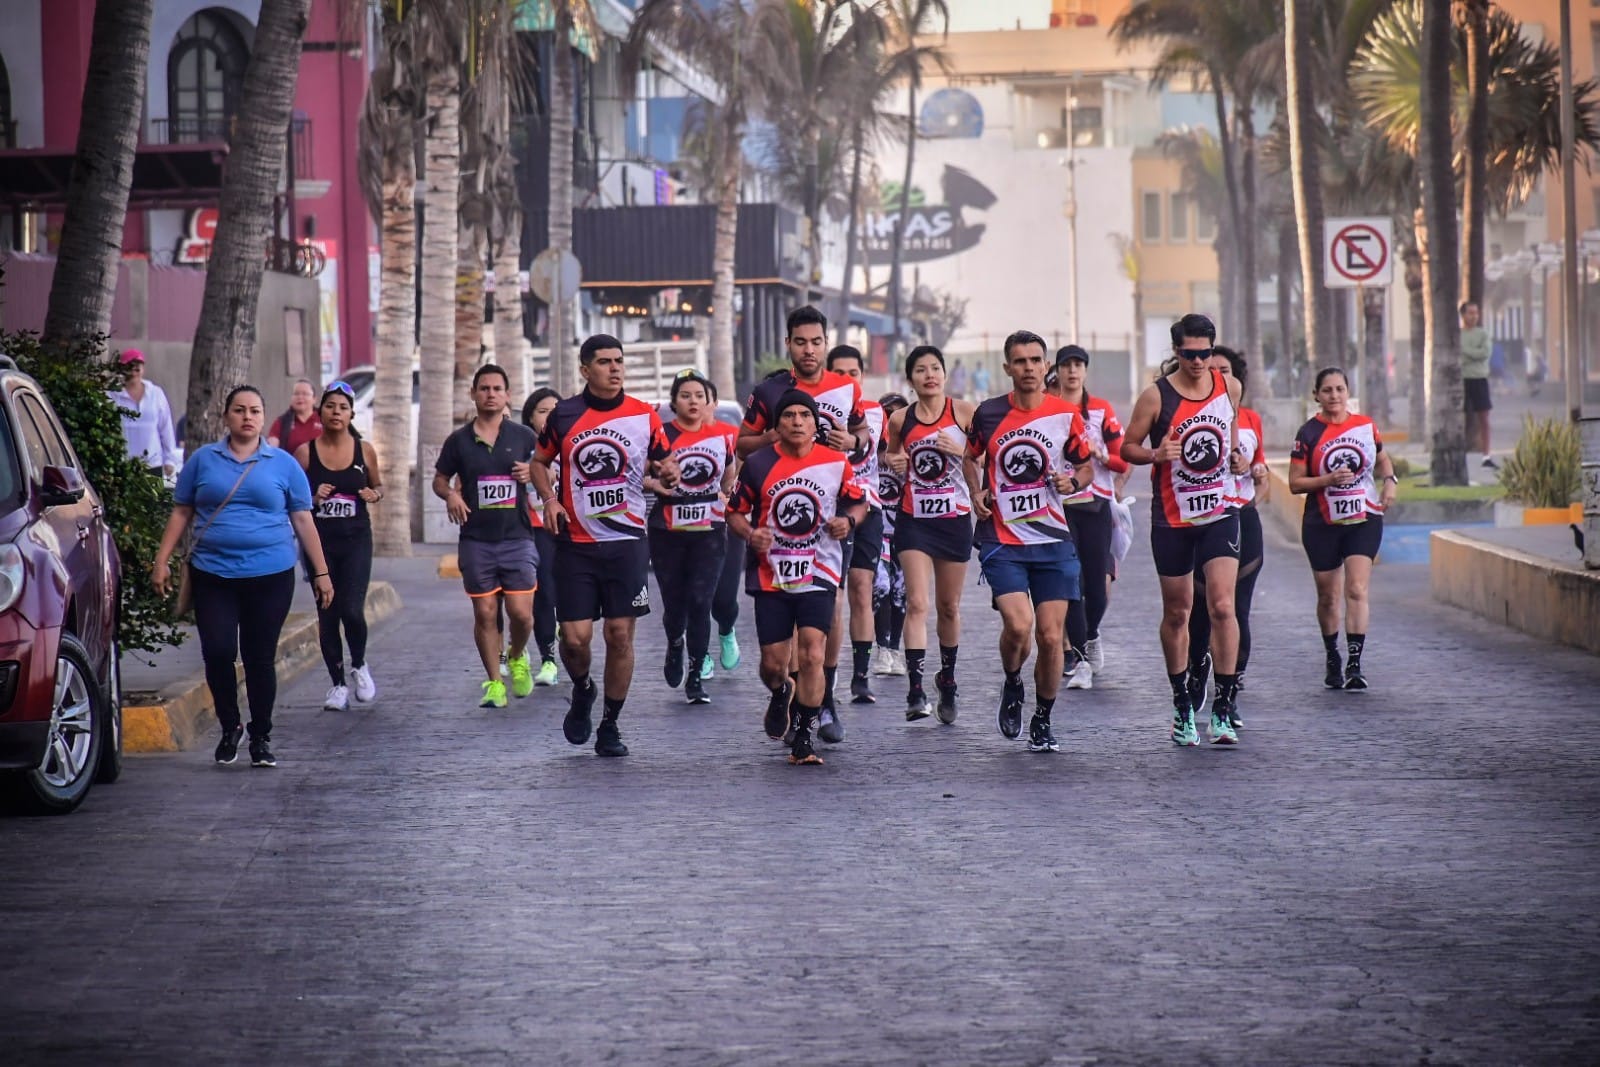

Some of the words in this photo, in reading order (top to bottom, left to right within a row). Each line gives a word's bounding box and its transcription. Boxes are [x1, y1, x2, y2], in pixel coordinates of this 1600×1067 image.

[1176, 415, 1227, 434] DEPORTIVO
[571, 428, 632, 447] DEPORTIVO
[997, 428, 1053, 449] DEPORTIVO
[1321, 437, 1365, 452] DEPORTIVO
[1177, 467, 1226, 485] DRAGONES
[482, 484, 513, 500] 1207
[768, 477, 826, 497] DEPORTIVO
[587, 488, 624, 508] 1066
[919, 498, 951, 515] 1221
[1009, 493, 1041, 513] 1211
[1187, 493, 1219, 512] 1175
[1333, 498, 1362, 515] 1210
[321, 501, 352, 518] 1206
[676, 505, 706, 520] 1067
[778, 560, 810, 578] 1216
